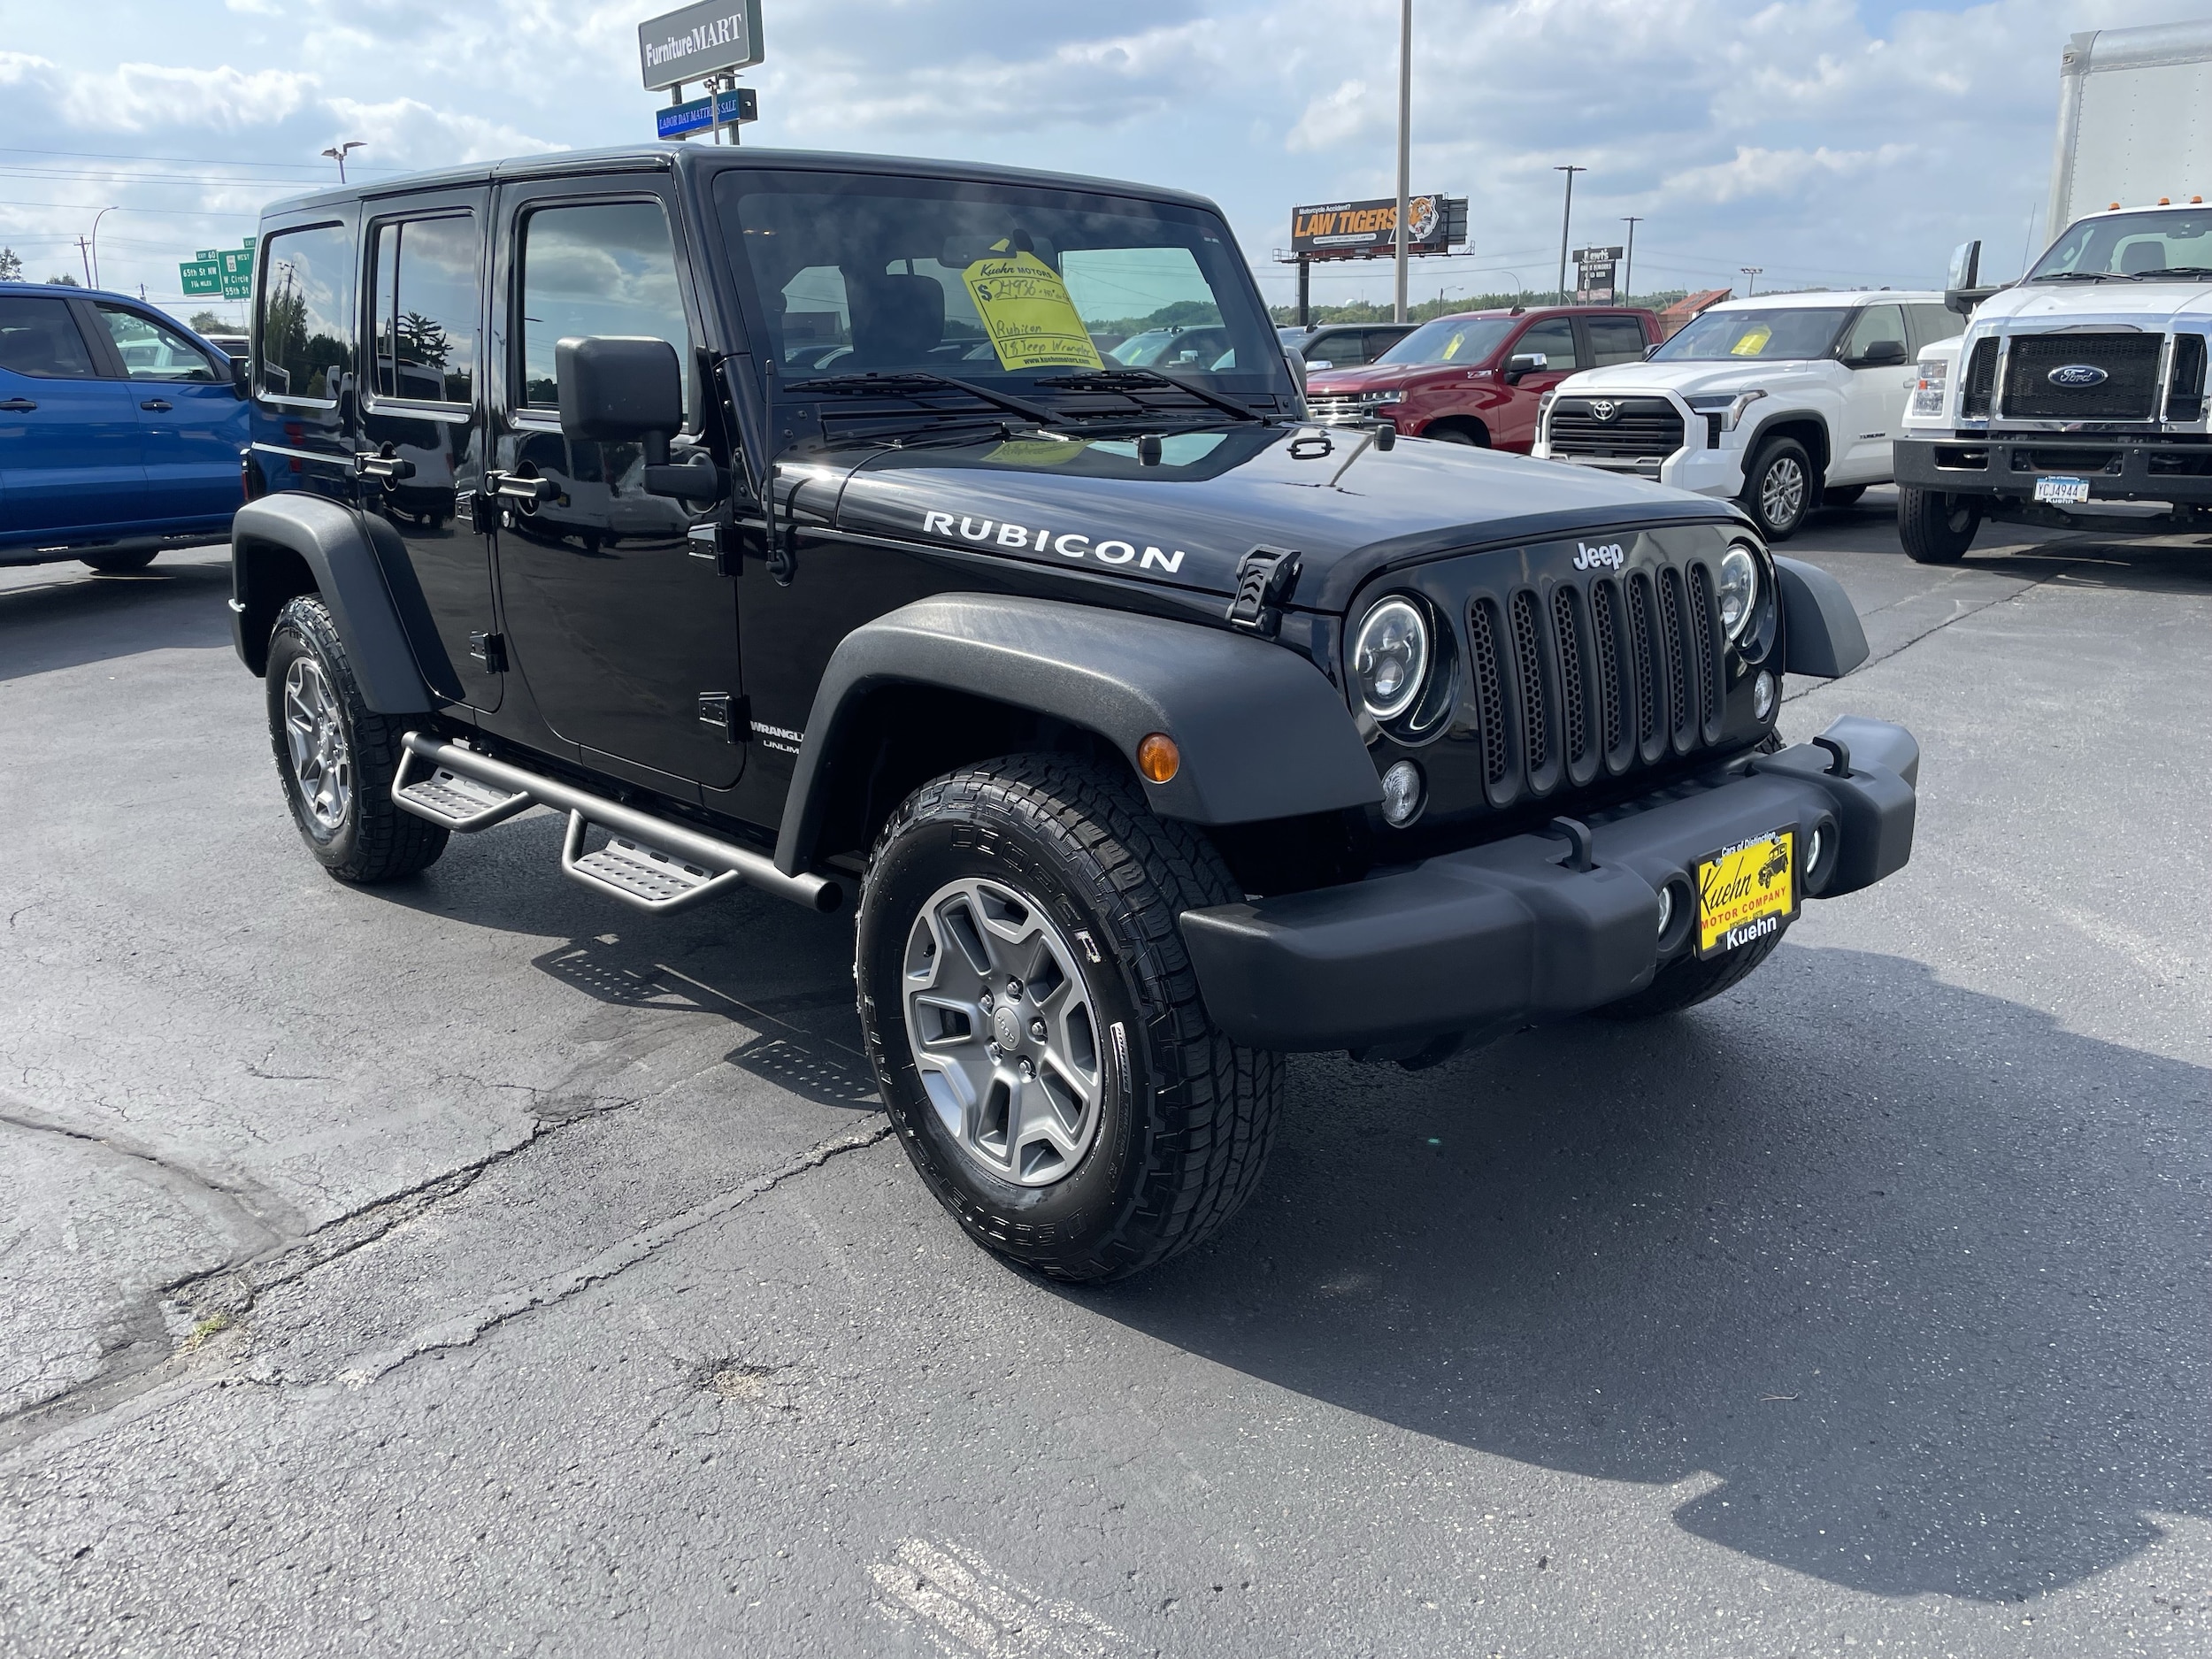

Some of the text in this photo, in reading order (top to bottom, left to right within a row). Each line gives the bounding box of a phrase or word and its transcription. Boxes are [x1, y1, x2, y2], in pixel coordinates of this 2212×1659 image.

[646, 13, 741, 67] FurnitureMART
[659, 99, 737, 130] LABOR DAY MATTRES SALE
[1325, 204, 1351, 212] Accident?
[1294, 207, 1396, 237] LAW TIGERS
[208, 250, 216, 259] 60
[183, 268, 197, 277] 65th
[199, 267, 206, 276] St
[231, 274, 249, 284] Circle
[980, 263, 1053, 280] Kuehn MOTORS
[225, 286, 250, 296] 55th St
[996, 320, 1042, 336] Rubicon
[1019, 340, 1047, 354] Jeep
[1052, 340, 1091, 356] Wrangler
[2060, 369, 2093, 382] Ford
[2039, 483, 2078, 497] YCJ4944
[923, 511, 1186, 573] RUBICON
[1573, 541, 1624, 571] Jeep
[1721, 831, 1776, 857] Cars of Distinction
[1700, 856, 1752, 916] Kuehn
[1701, 886, 1786, 930] MOTOR COMPANY
[1726, 917, 1778, 950] Kuehn
